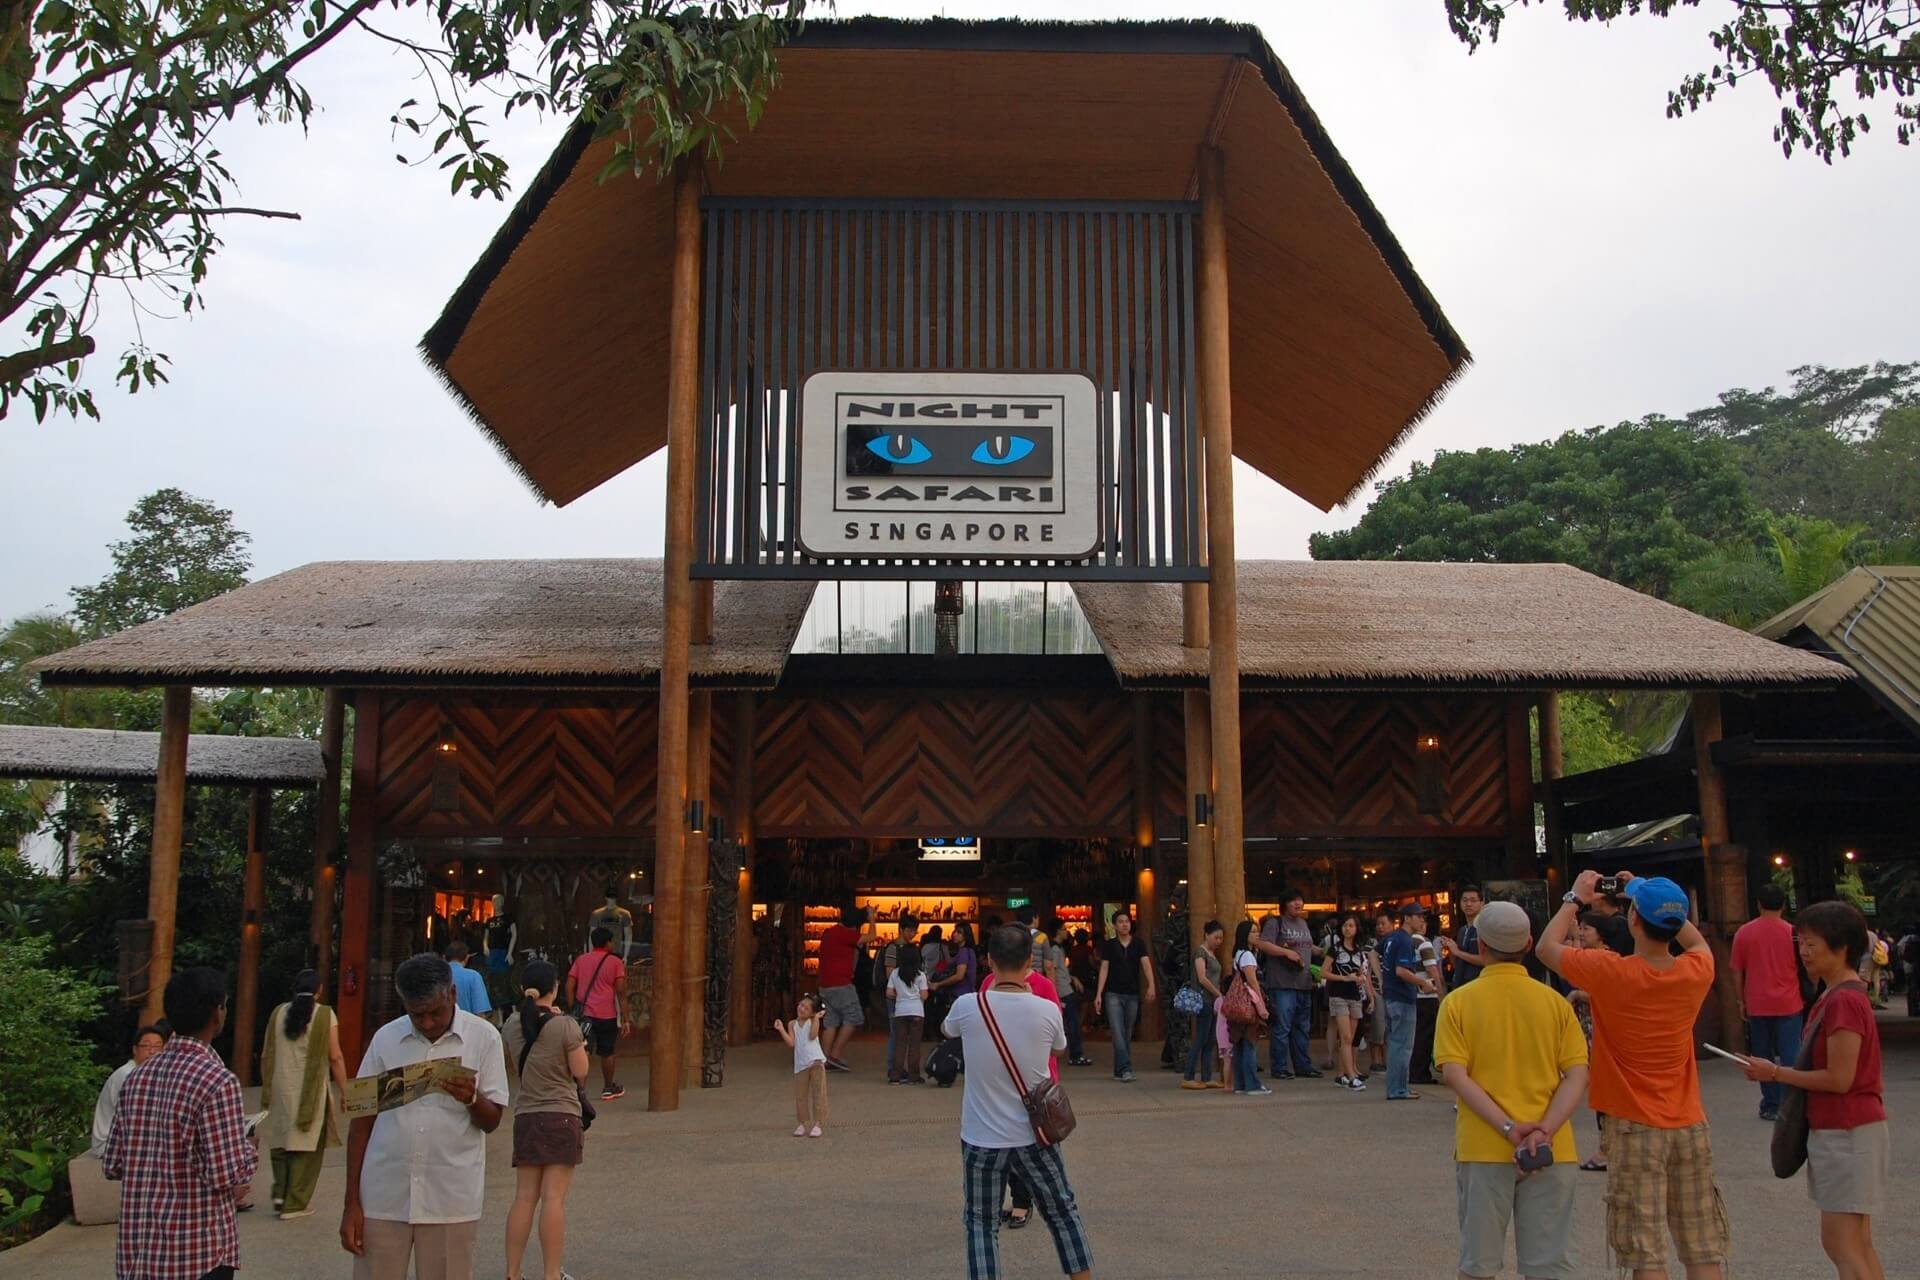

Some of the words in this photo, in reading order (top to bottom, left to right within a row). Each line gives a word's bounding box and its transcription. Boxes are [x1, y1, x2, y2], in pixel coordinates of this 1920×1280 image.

[847, 403, 1052, 418] NIGHT
[846, 485, 1053, 502] SAFARI
[845, 522, 1054, 542] SINGAPORE
[1011, 899, 1025, 908] EXIT
